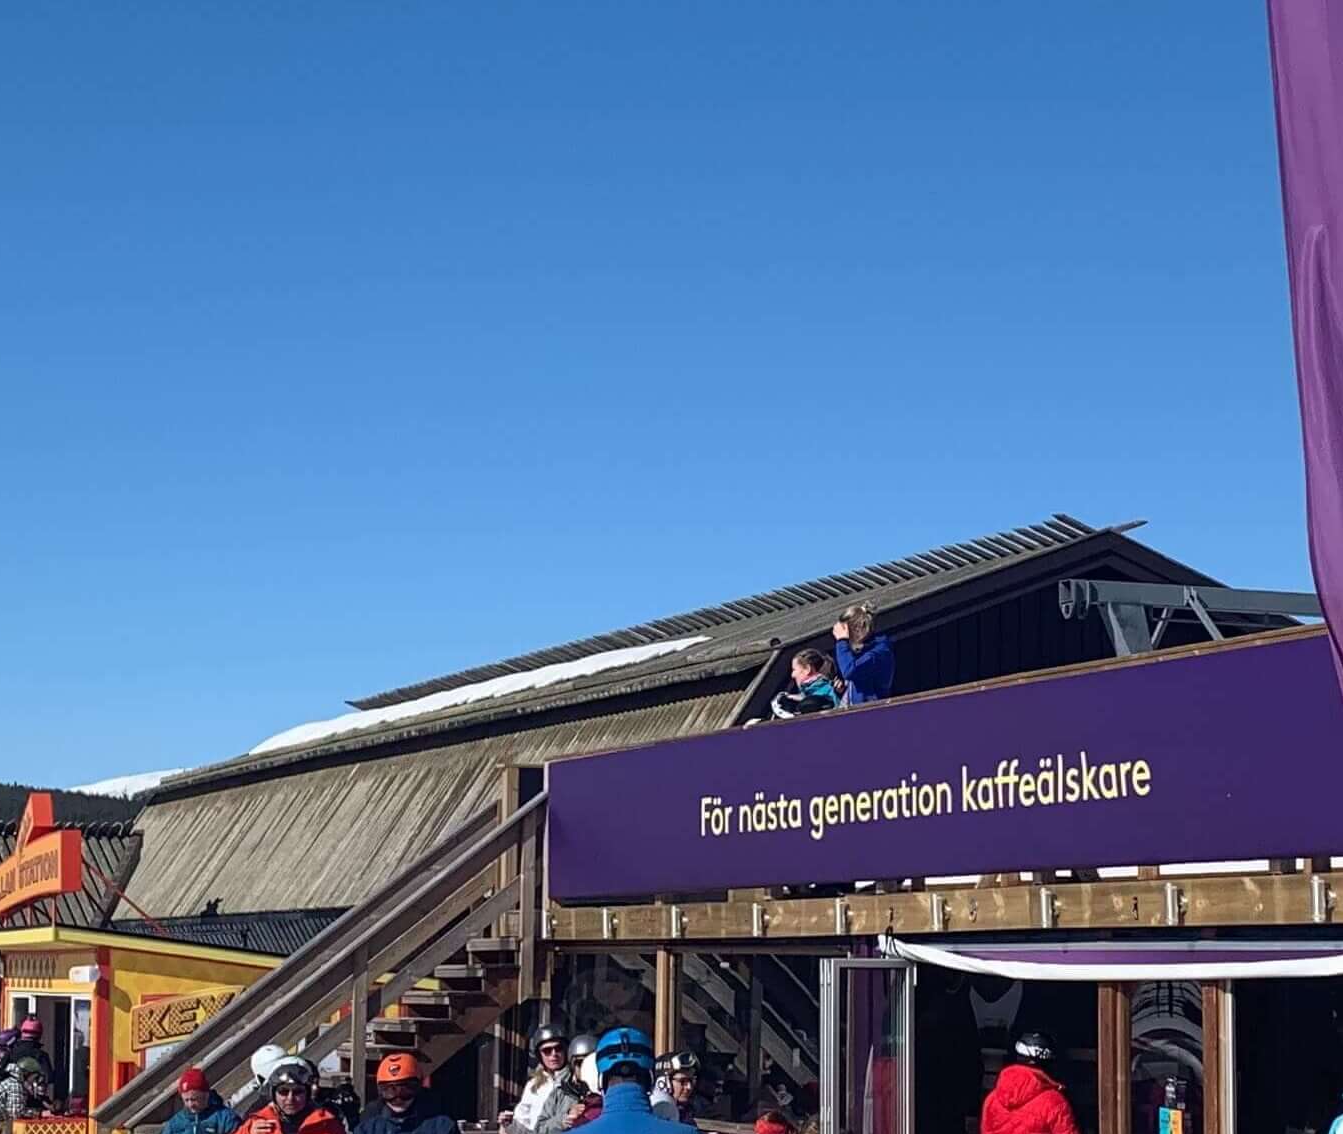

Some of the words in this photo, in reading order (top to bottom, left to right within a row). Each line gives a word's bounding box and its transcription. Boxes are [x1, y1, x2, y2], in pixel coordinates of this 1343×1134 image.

[700, 795, 733, 837] För
[738, 791, 803, 833] nästa
[809, 773, 952, 840] generation
[961, 751, 1152, 813] kaffeälskare
